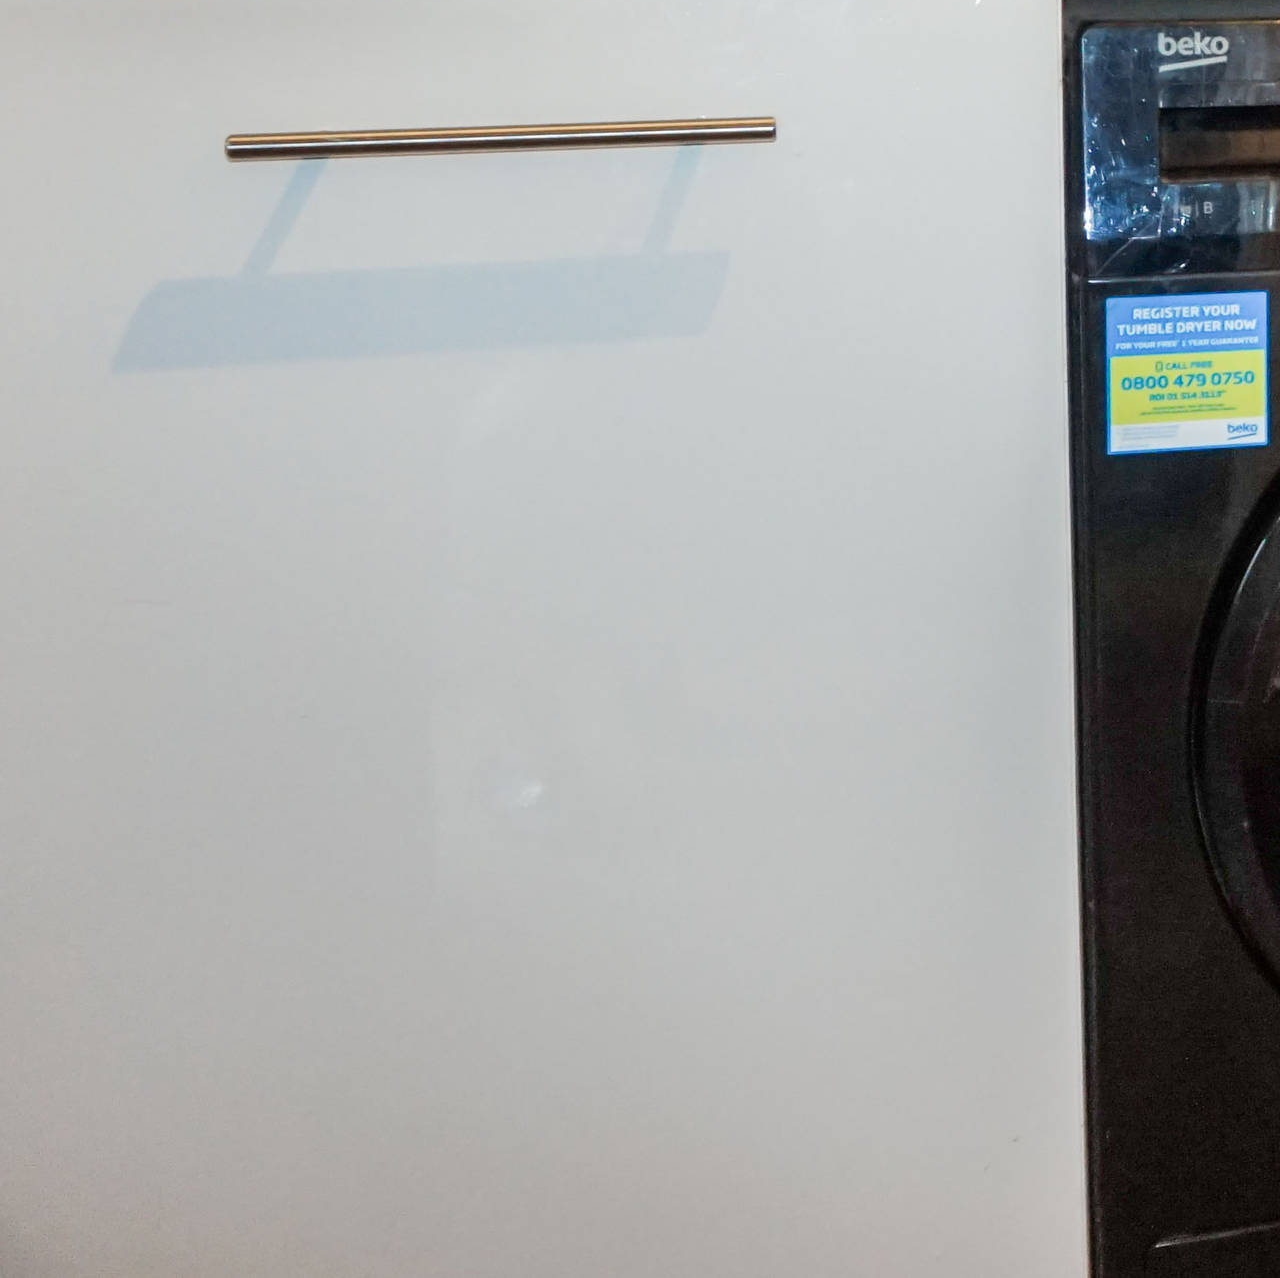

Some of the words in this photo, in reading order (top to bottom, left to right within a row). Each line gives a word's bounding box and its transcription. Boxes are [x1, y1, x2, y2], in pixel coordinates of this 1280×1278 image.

[1158, 32, 1229, 56] beko
[1133, 307, 1199, 320] REGISTER
[1202, 304, 1240, 317] YOUR
[1117, 324, 1173, 336] TUMBLE
[1176, 321, 1221, 334] DRYER
[1224, 319, 1257, 331] NOW
[1115, 342, 1132, 350] FOR
[1134, 341, 1155, 350] YOUR
[1188, 338, 1209, 346] YEAR
[1165, 362, 1188, 370] CALL
[1121, 375, 1169, 391] 0800
[1173, 373, 1206, 388] 479
[1211, 370, 1255, 385] 0750
[1227, 423, 1258, 434] beko
